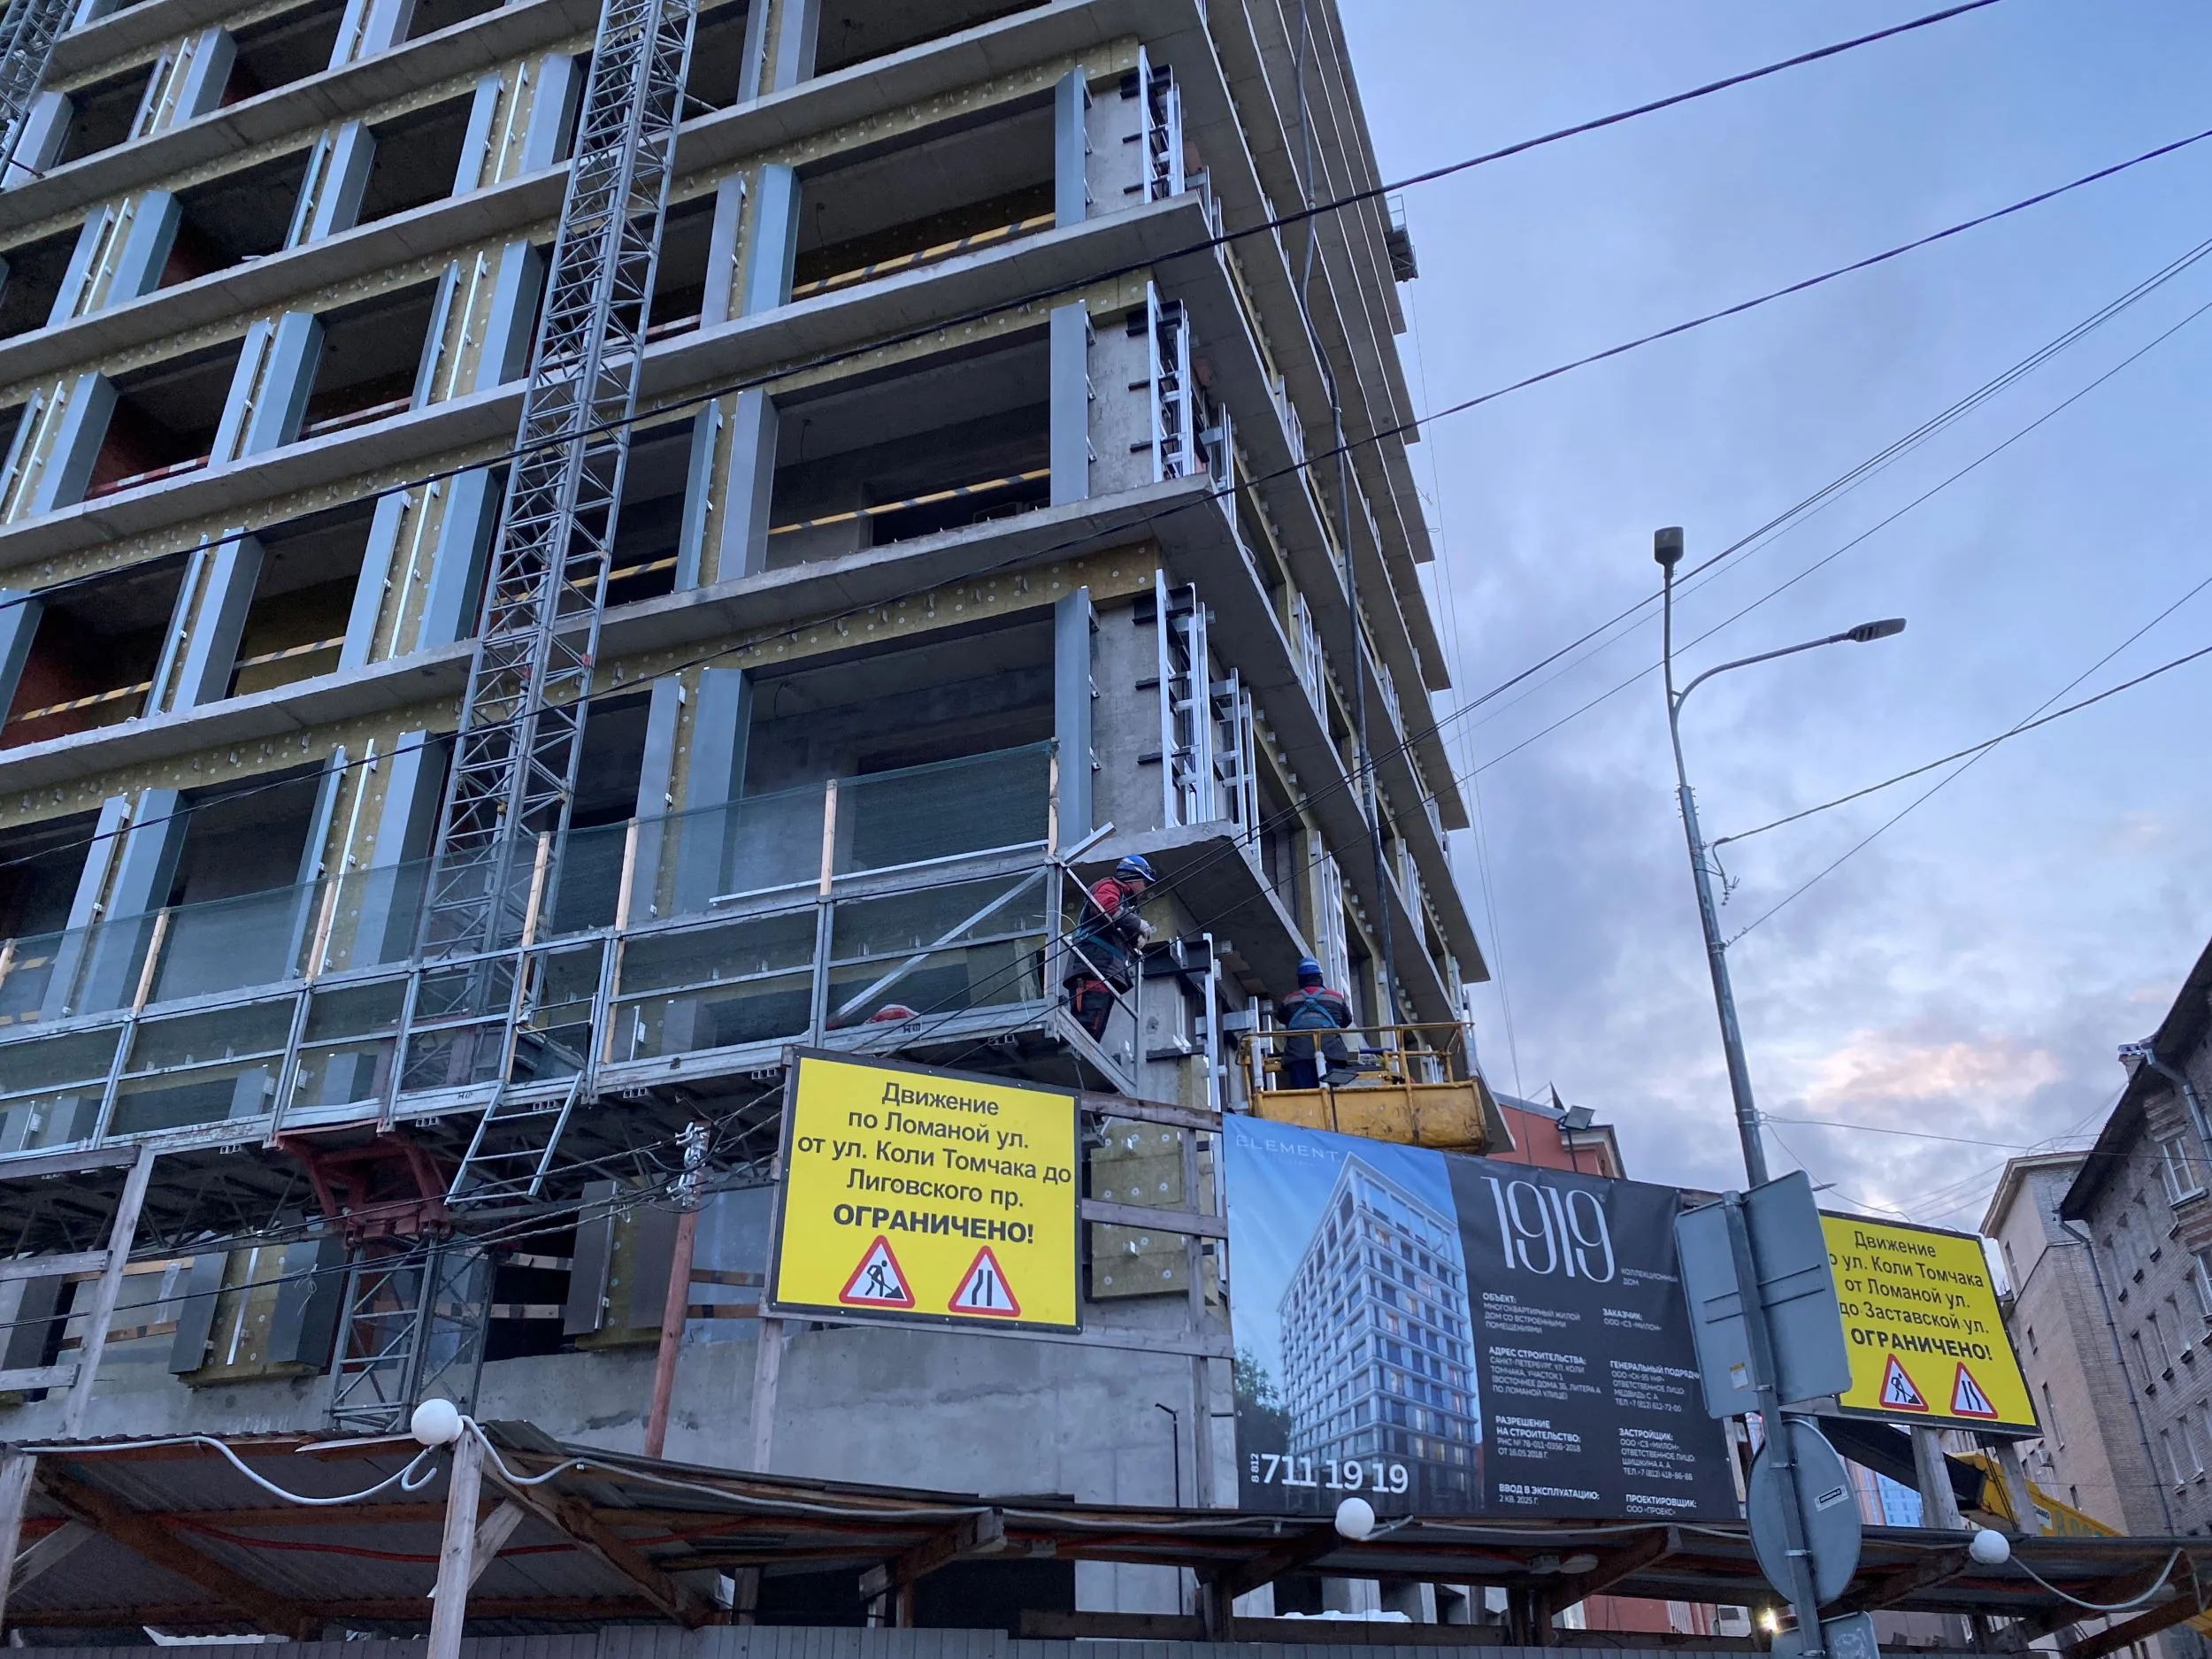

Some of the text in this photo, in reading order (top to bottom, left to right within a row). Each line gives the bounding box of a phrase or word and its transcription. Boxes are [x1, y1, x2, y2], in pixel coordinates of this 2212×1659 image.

[882, 1082, 999, 1116] Движение
[849, 1111, 1029, 1150] по Ломаной ул.
[1236, 1134, 1339, 1162] ELEMENT
[797, 1136, 1071, 1187] от ул. Коли Томчака до
[847, 1168, 1024, 1210] Лиговского пр.
[833, 1203, 1033, 1244] ОГРАНИЧЕНО!
[1480, 1176, 1615, 1283] 1919
[1855, 1230, 1937, 1257] Движение
[1844, 1255, 1868, 1271] ул.
[1871, 1256, 1913, 1277] Коли
[1916, 1263, 1984, 1287] Томчака
[1483, 1293, 1517, 1304] ОБЪЕКТ:
[1845, 1279, 1970, 1310] от Ломаной ул.
[1485, 1311, 1502, 1320] ДОМ
[1602, 1308, 1643, 1320] ЗАКАЗЧИК:
[1840, 1302, 1989, 1335] до Заставской ул.
[1851, 1328, 1993, 1361] ОГРАНИЧЕНО!
[1489, 1347, 1586, 1364] АДРЕС СТРОИТЕЛЬСТВА:
[1610, 1360, 1663, 1374] ГЕНЕРАЛЬНЫЙ
[1537, 1379, 1557, 1389] ДОМА
[1495, 1415, 1550, 1429] РАЗРЕШЕНИЕ
[1496, 1426, 1581, 1443] НА СТРОИТЕЛЬСТВО:
[1619, 1428, 1674, 1441] ЗАСТРОЙЩИК:
[1620, 1438, 1636, 1447] ООО
[1250, 1453, 1260, 1474] 812
[1621, 1448, 1676, 1460] ОТВЕТСТВЕННОЕ
[1261, 1454, 1409, 1494] 711 19 19
[1499, 1484, 1600, 1501] ВВОД В ЭКСПЛУАТАЦИЮ:
[1517, 1495, 1533, 1504] 2025
[1625, 1494, 1697, 1509] ПРОЕКТИРОВЩИК:
